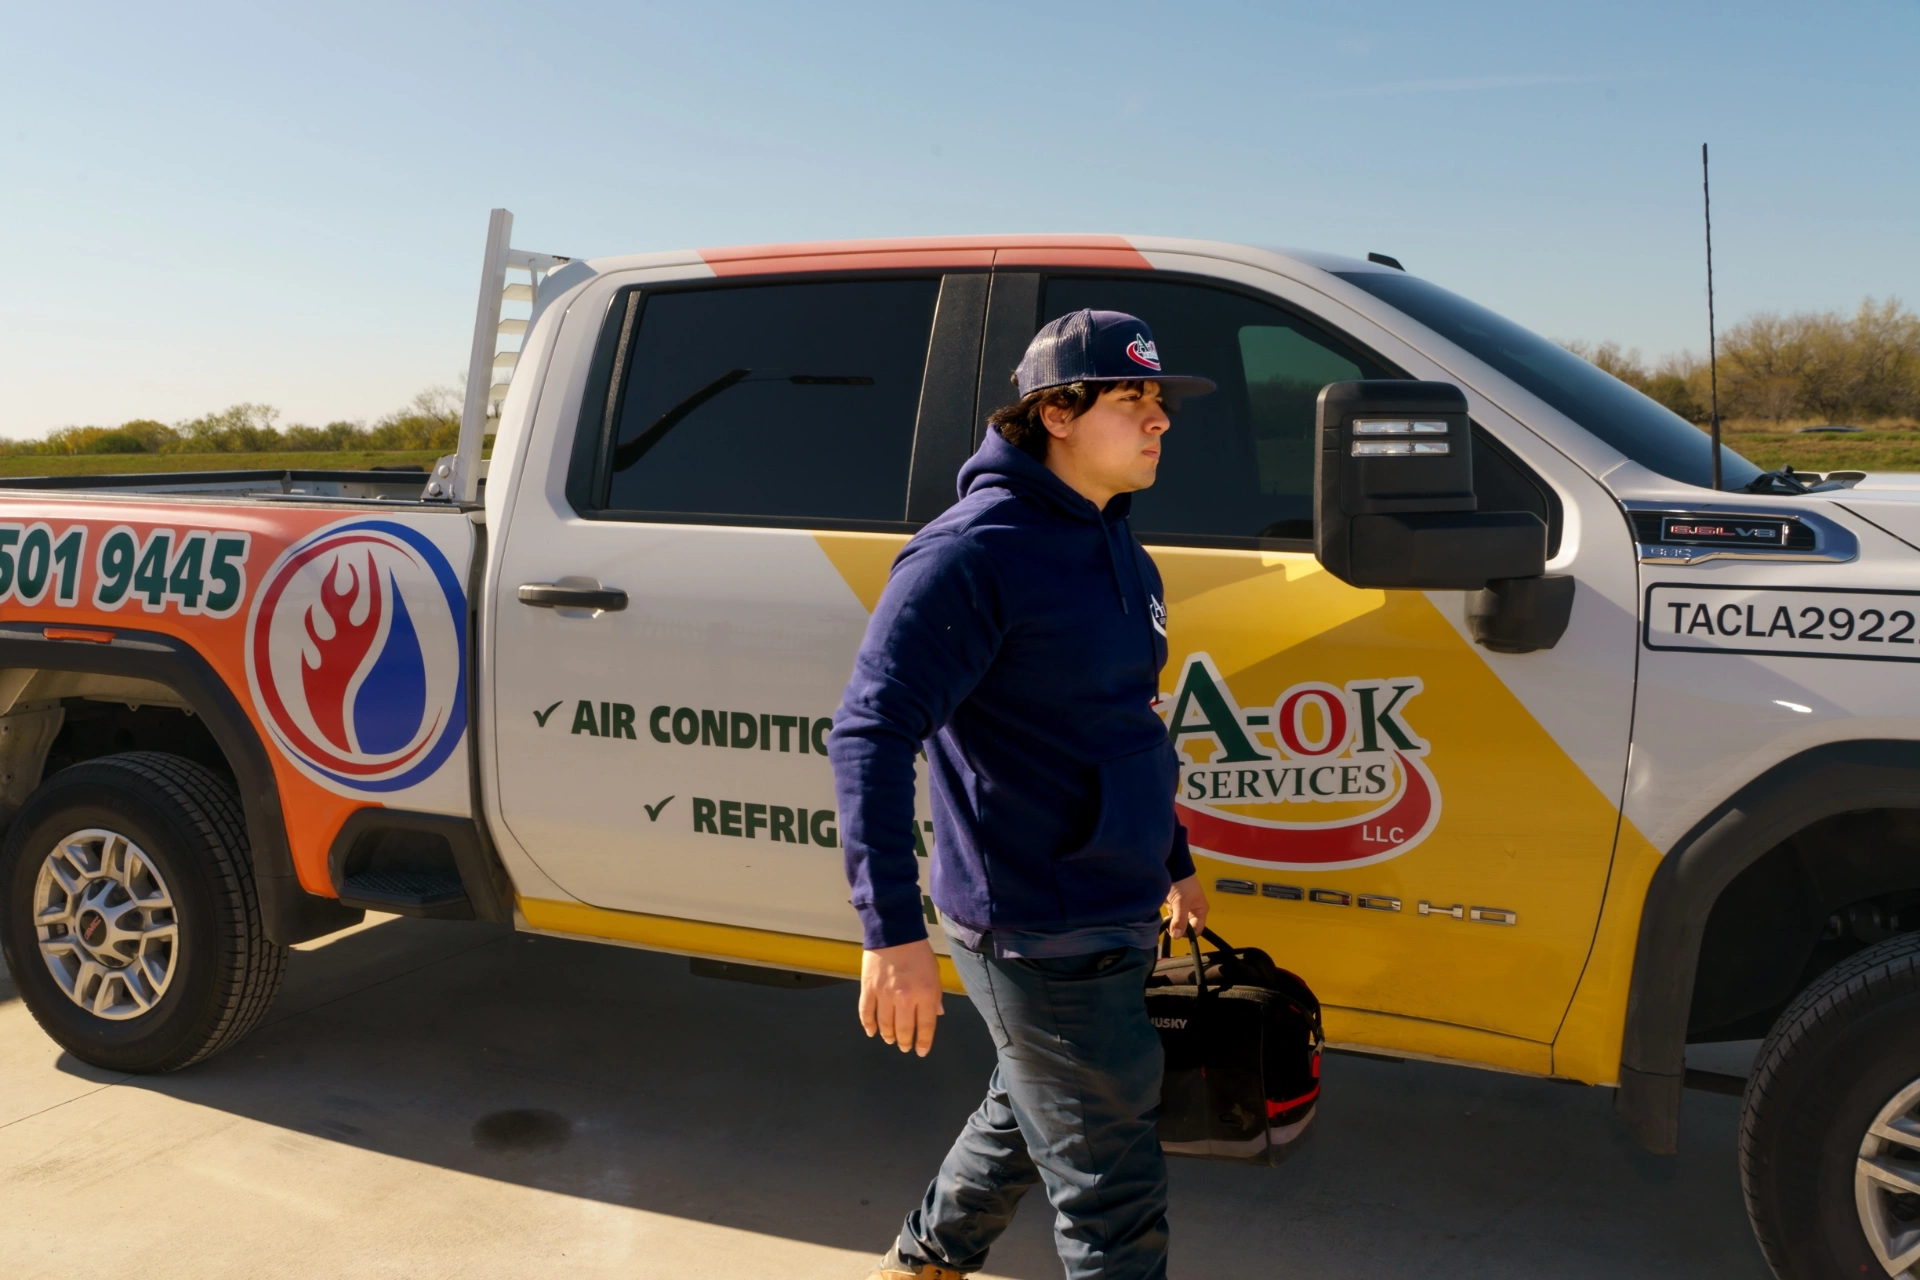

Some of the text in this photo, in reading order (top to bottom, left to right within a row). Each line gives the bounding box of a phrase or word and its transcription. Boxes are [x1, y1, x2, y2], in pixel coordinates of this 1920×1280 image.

[97, 531, 246, 612] 9445
[1668, 602, 1920, 645] TACLA2922
[571, 700, 928, 763] AIR CONDITIO
[1168, 661, 1421, 766] A-OK
[1187, 764, 1386, 801] SERVICES
[1362, 824, 1405, 844] LLC
[1418, 900, 1516, 925] HD
